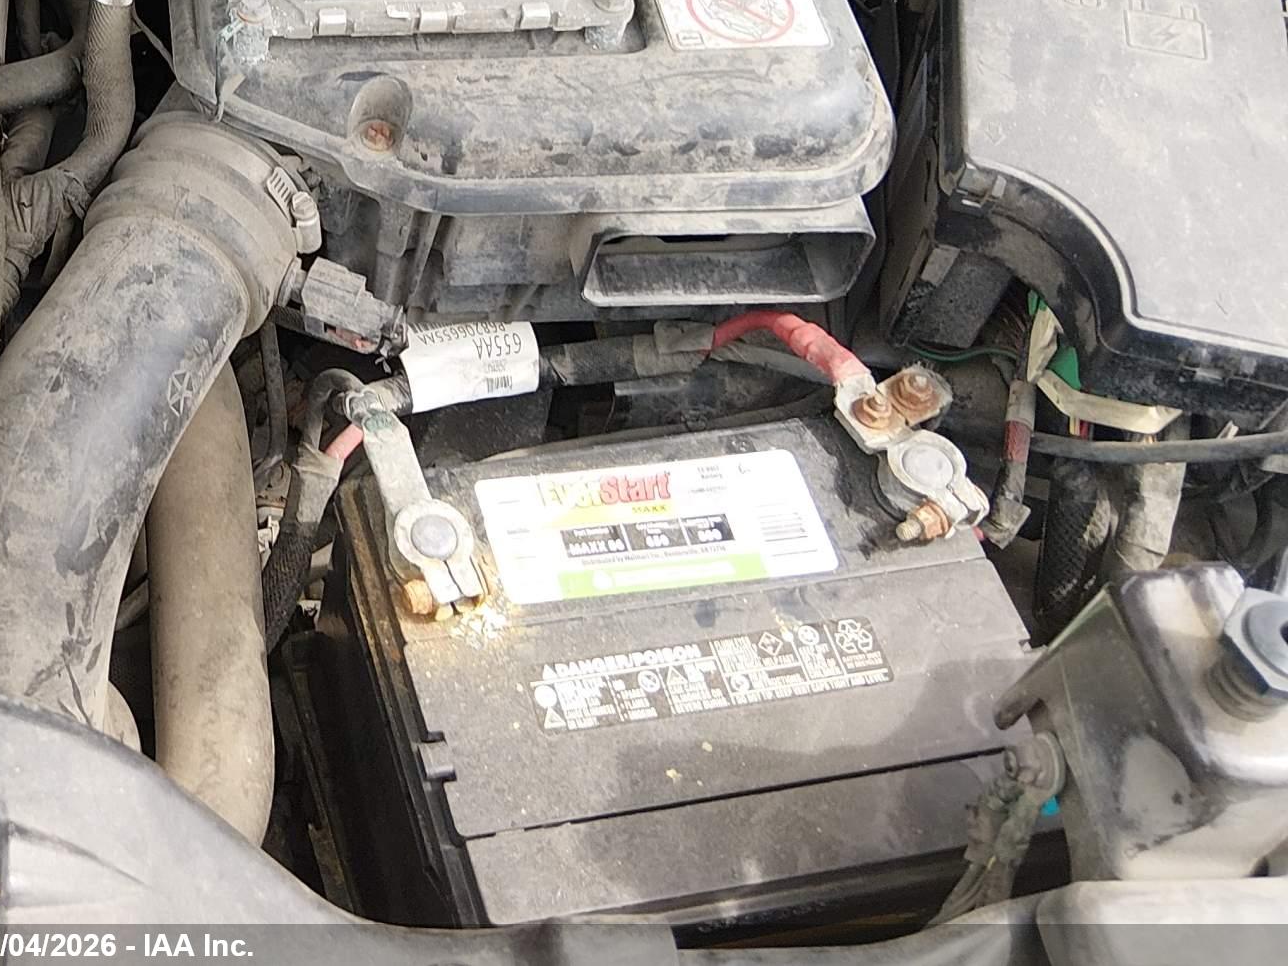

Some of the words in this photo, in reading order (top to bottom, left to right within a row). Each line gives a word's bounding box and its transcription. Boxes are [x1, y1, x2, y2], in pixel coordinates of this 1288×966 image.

[472, 332, 522, 361] 655AA
[537, 470, 671, 508] EverStart
[568, 540, 606, 556] MAXX
[555, 644, 702, 676] DANGER/POISON
